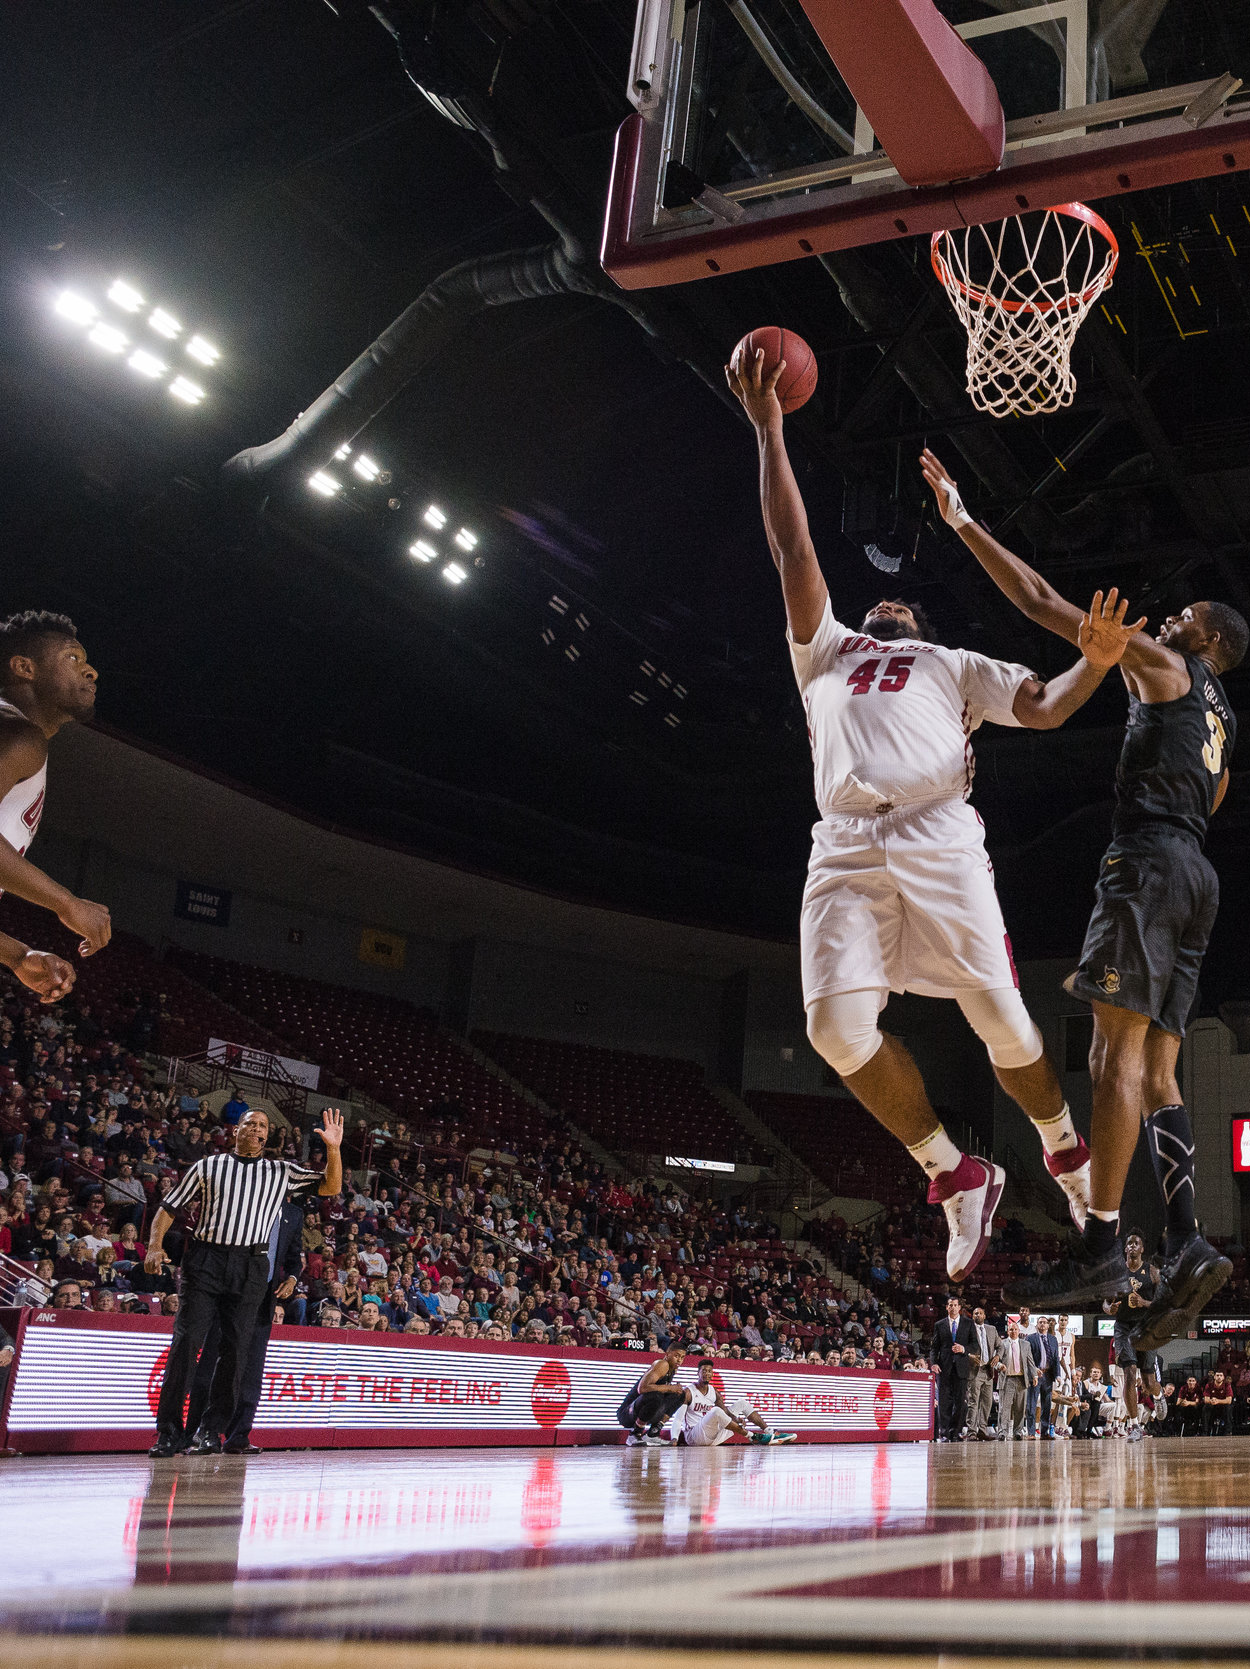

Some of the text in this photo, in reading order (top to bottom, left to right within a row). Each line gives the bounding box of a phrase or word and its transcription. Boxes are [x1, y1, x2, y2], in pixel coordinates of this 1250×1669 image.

[846, 656, 916, 696] 45
[188, 890, 221, 906] SAINT
[187, 903, 218, 918] LOUIS
[34, 1312, 57, 1323] ANC
[628, 1339, 645, 1350] POSS
[264, 1373, 348, 1401] TASTE
[356, 1375, 403, 1402] THE
[409, 1378, 502, 1405] FEELING
[788, 1393, 810, 1412] THE
[814, 1394, 859, 1413] FEELING
